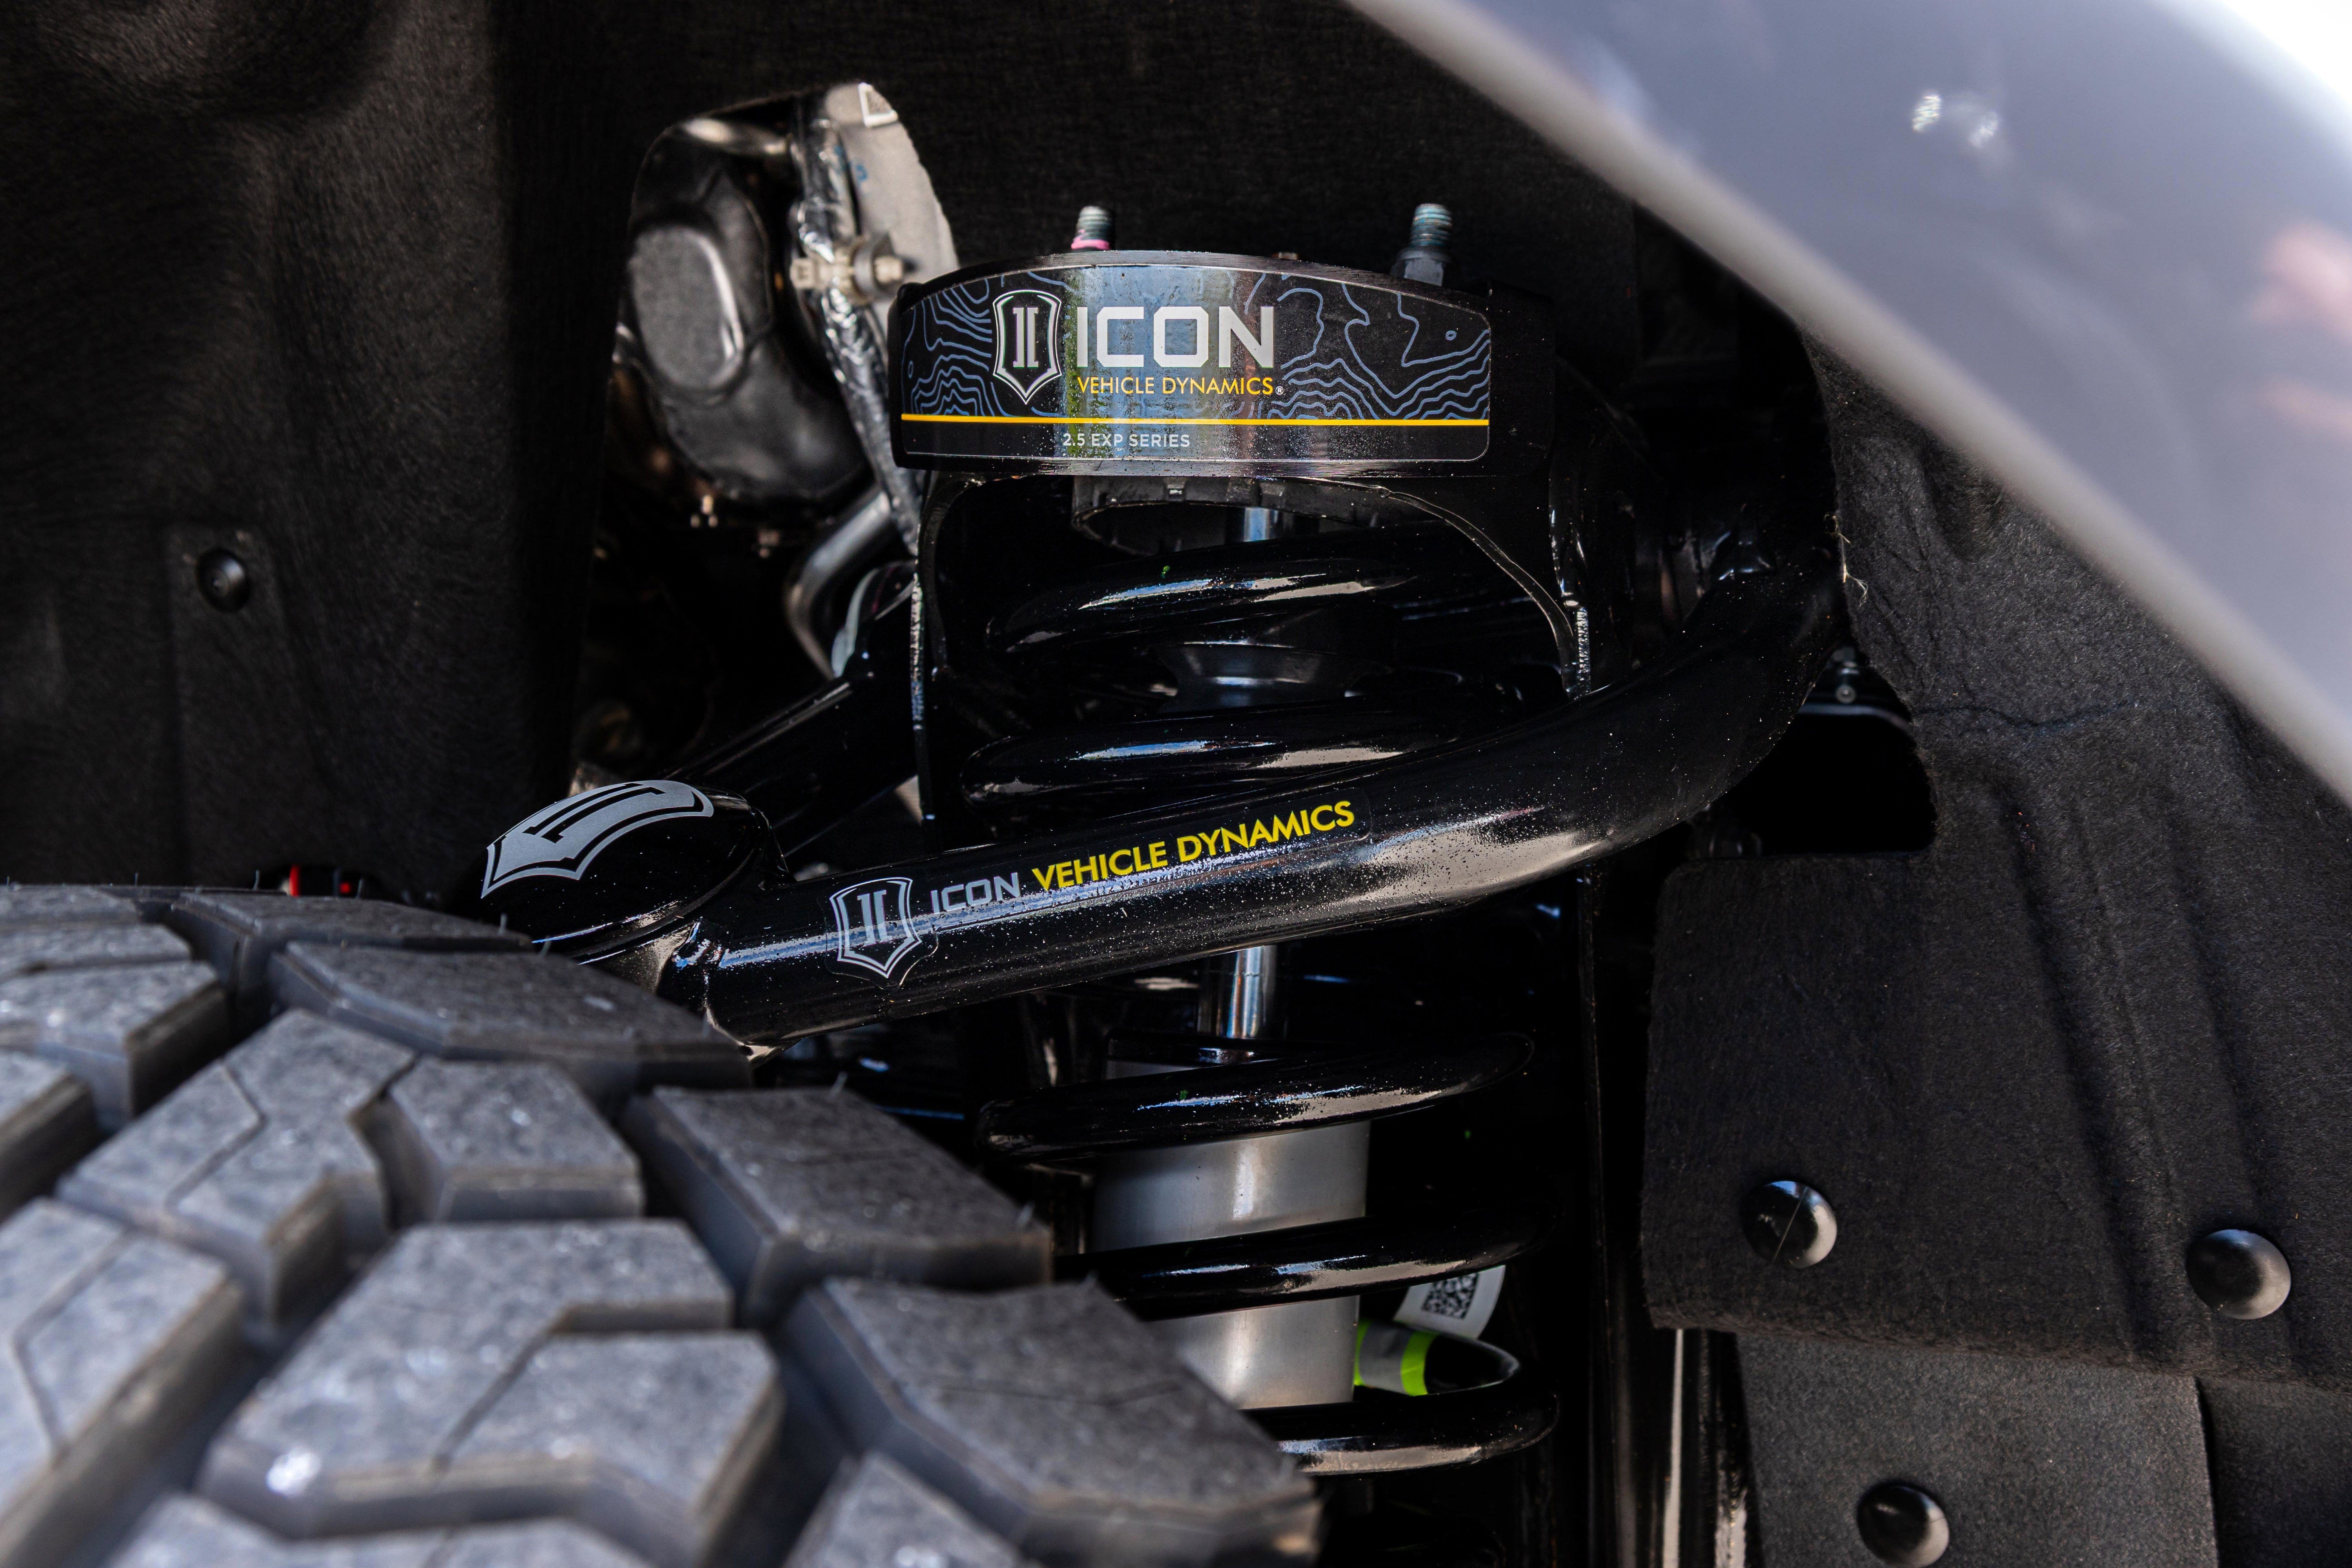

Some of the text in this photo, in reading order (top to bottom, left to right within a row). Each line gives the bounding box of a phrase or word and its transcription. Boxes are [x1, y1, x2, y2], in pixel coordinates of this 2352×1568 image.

[1077, 306, 1274, 368] ICON
[1077, 376, 1154, 394] VEHICLE
[1062, 433, 1190, 448] 2.5 EXP SERIES
[930, 800, 1355, 914] ICON VEHICLE DYNAMICS
